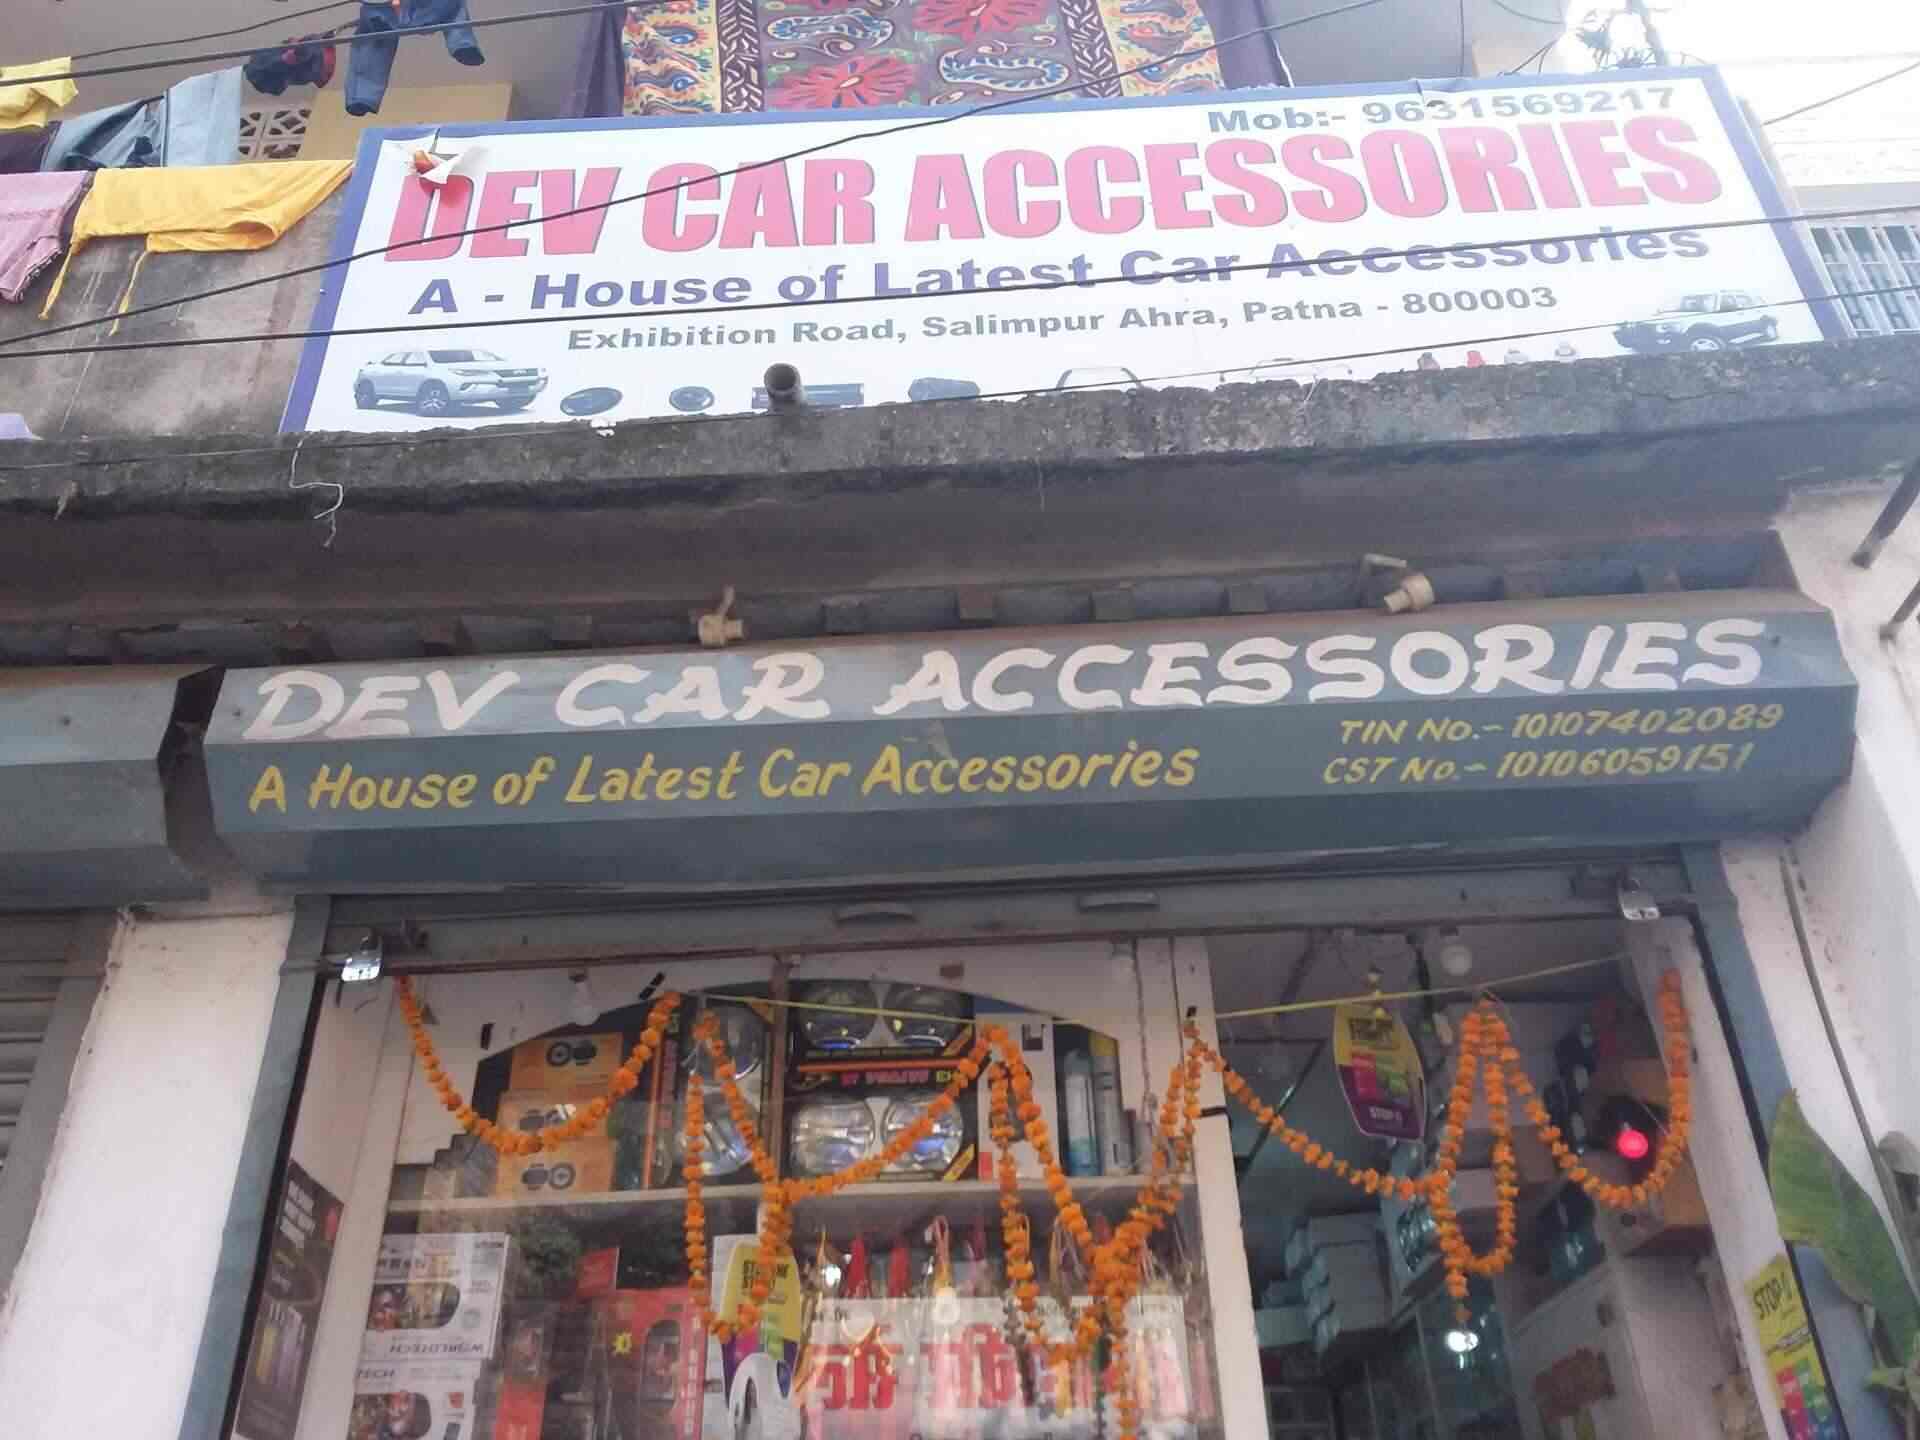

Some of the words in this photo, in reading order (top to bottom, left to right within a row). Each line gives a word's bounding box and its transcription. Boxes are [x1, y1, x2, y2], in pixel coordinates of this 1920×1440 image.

[1208, 108, 1346, 133] Mob:-
[1361, 87, 1675, 126] 9631569217
[384, 166, 622, 262] DEV
[641, 157, 876, 252] CAR
[904, 115, 1723, 242] ACCESSORIES
[408, 278, 458, 314] A
[530, 271, 754, 310] House
[777, 262, 846, 303] of
[874, 253, 1095, 299] Latest
[1119, 249, 1240, 285] Car
[1266, 226, 1711, 280] Accessories
[567, 322, 777, 350] Exhibition
[793, 317, 907, 344] Road,
[921, 309, 1104, 338] Salimpur
[1119, 303, 1229, 329] Ahra,
[1244, 298, 1363, 323] Patna
[1402, 287, 1558, 315] 800003
[241, 669, 521, 740] DEV
[555, 651, 831, 728] CAR
[872, 618, 1766, 714] ACCESSORIES
[1339, 718, 1408, 745] TIN
[1510, 703, 1785, 740] 10107402089
[248, 764, 288, 813] A
[308, 761, 478, 811] House
[493, 755, 556, 805] of
[565, 750, 745, 804] Latest
[759, 748, 853, 798] Car
[861, 739, 1201, 796] Accessories
[1323, 755, 1394, 785] CST
[1496, 742, 1757, 781] 10106059151
